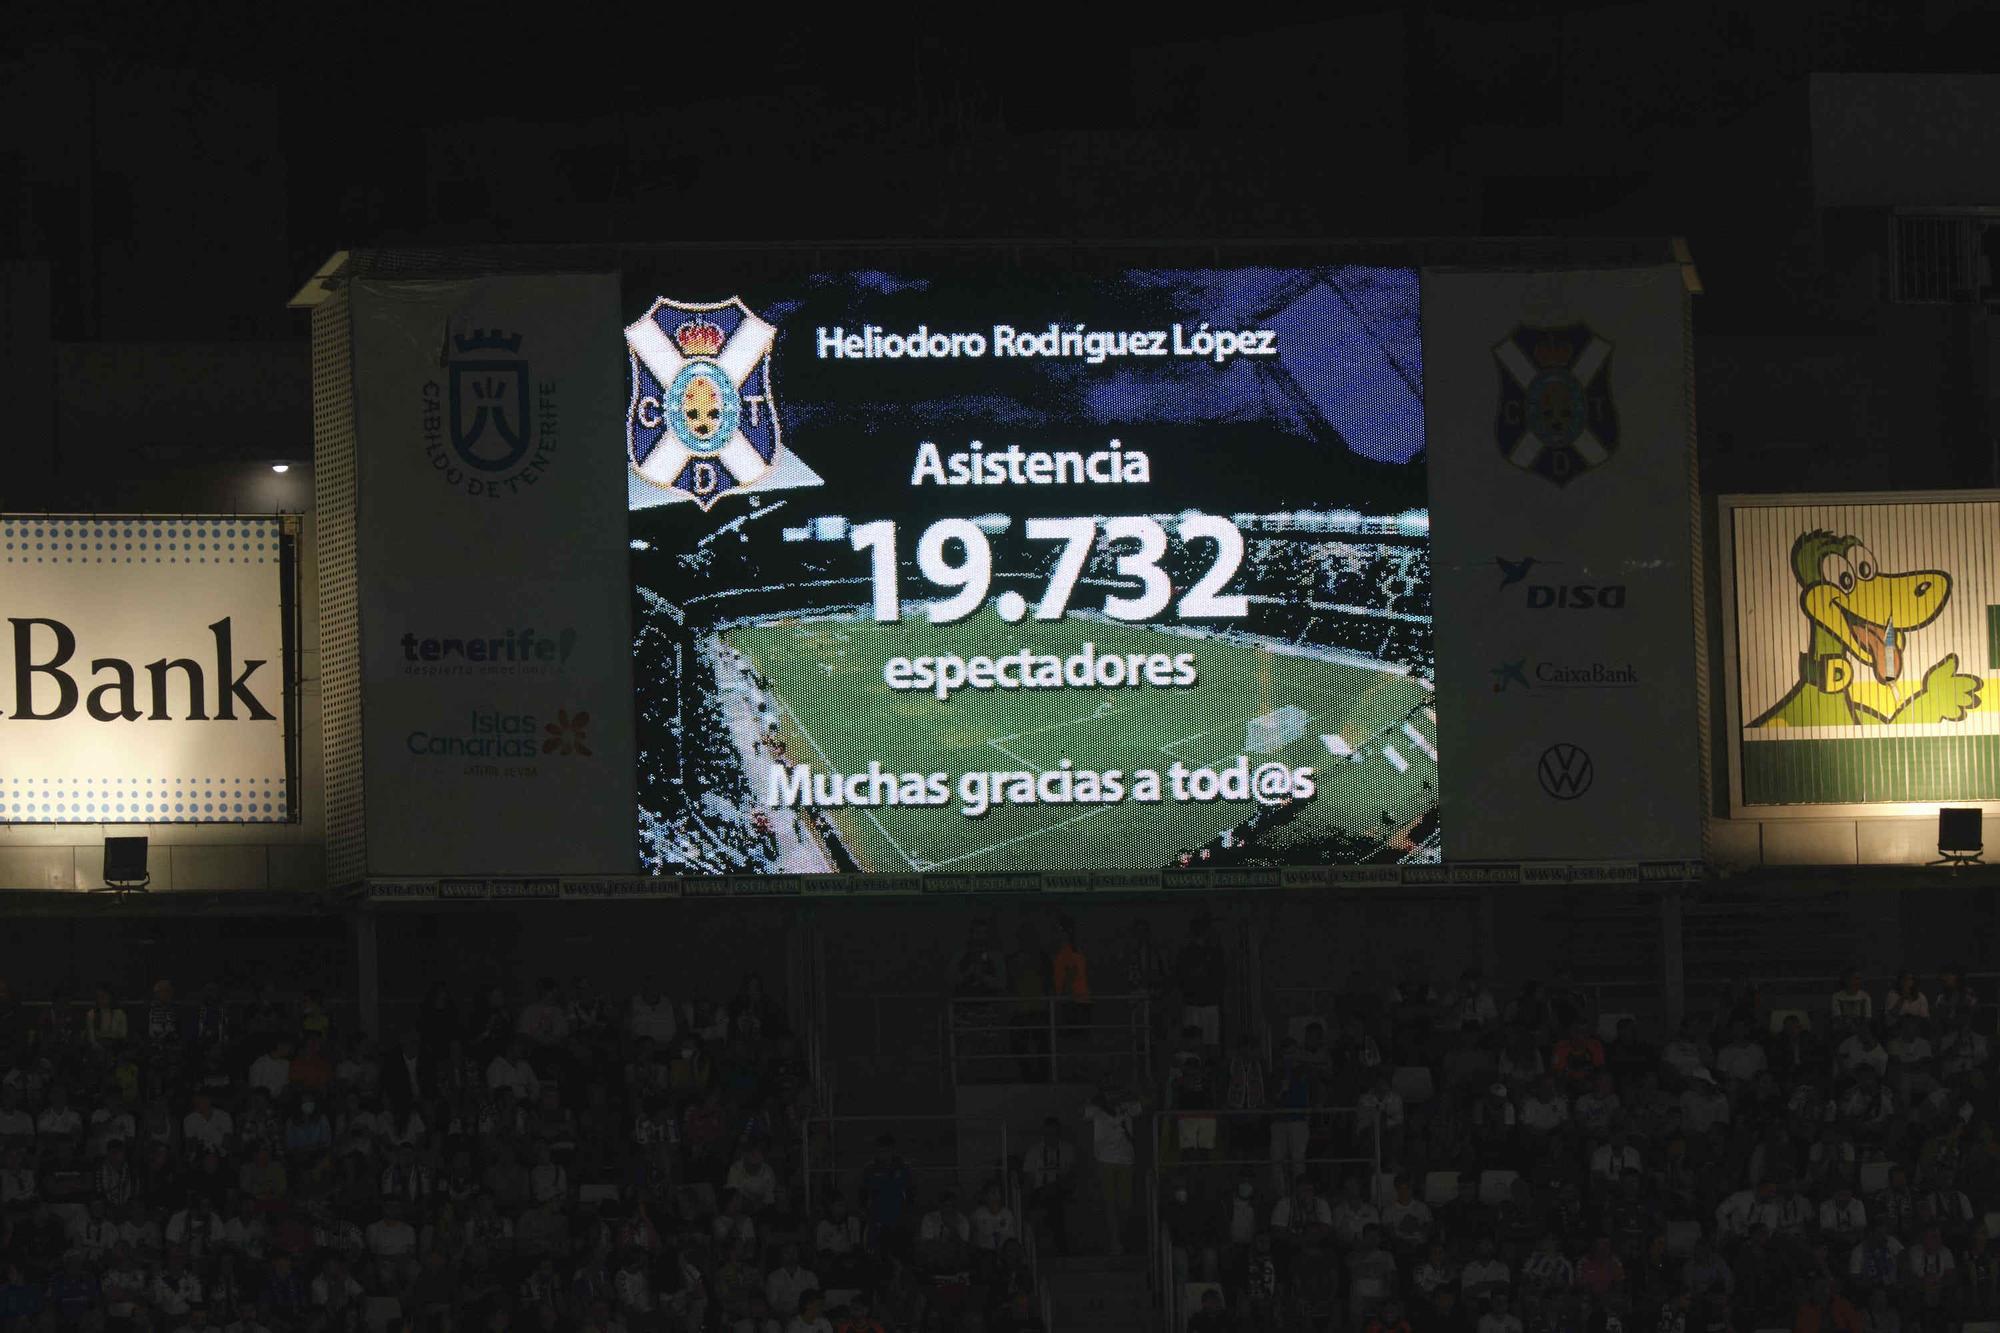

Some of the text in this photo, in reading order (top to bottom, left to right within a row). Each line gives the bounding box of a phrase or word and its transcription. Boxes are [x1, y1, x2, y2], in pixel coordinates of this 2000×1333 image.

[816, 322, 1277, 363] Heliodoro Rodríguez López
[638, 397, 662, 428] C
[743, 395, 764, 427] T
[423, 379, 558, 498] CABILDO DE TENERIFE
[694, 463, 718, 495] D
[911, 439, 1150, 486] Asistencia
[851, 514, 1249, 624] 19.732
[0, 616, 277, 722] Bank
[884, 642, 1198, 700] espectadores
[1536, 662, 1639, 684] CaixaBank
[472, 711, 537, 735] Islas
[407, 731, 537, 758] Canarias
[768, 757, 1316, 815] Muchas gracias a tod@s
